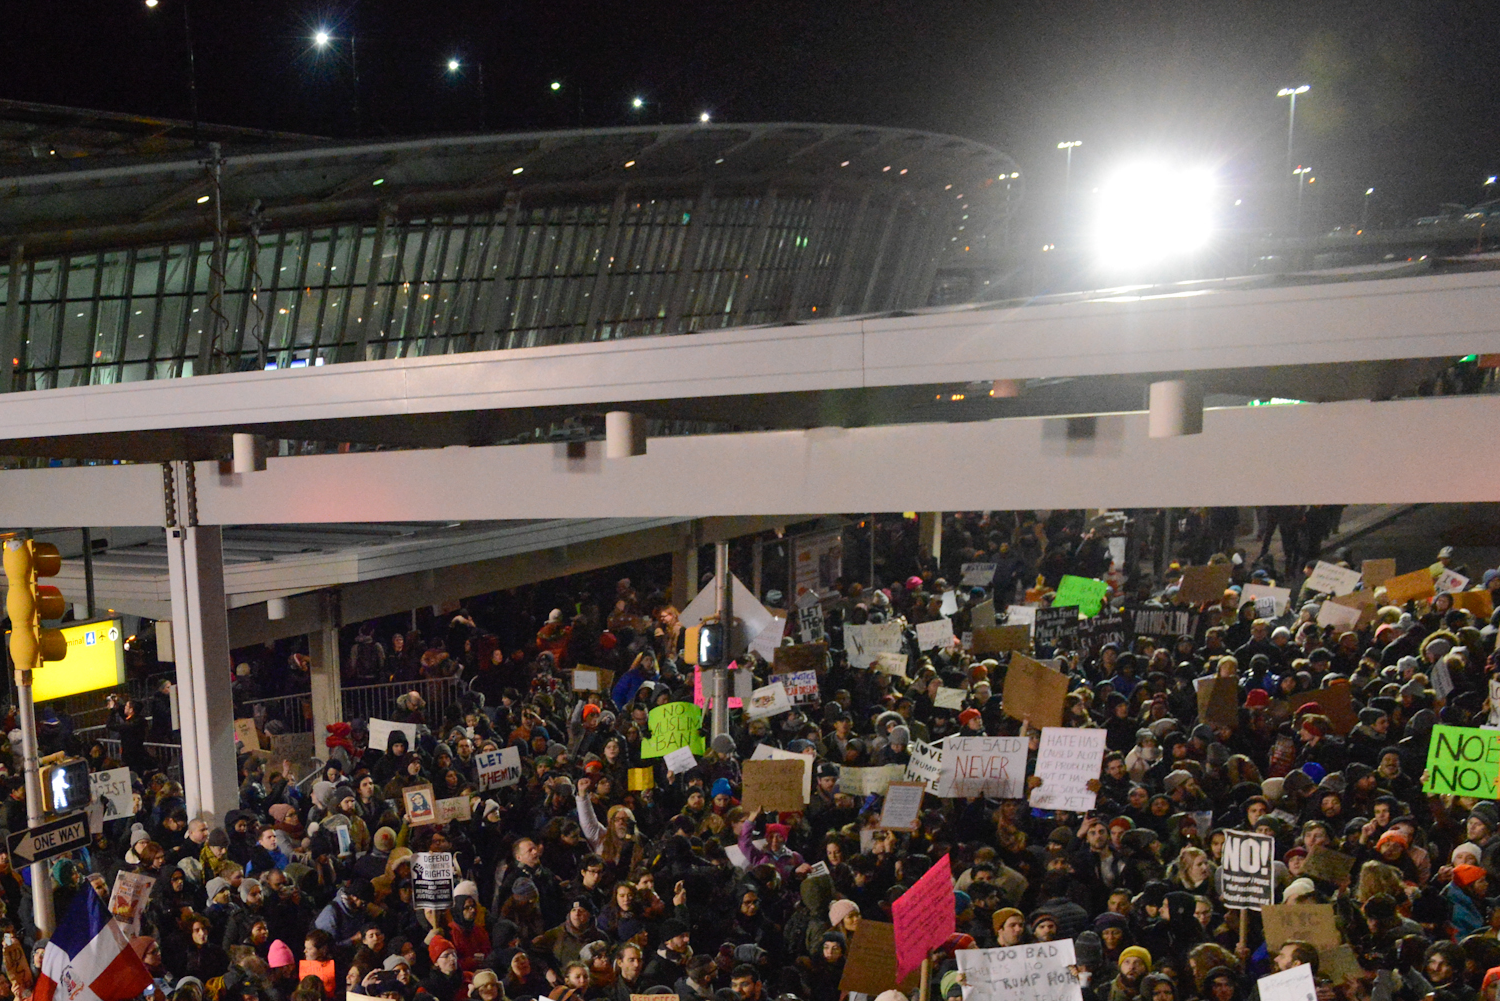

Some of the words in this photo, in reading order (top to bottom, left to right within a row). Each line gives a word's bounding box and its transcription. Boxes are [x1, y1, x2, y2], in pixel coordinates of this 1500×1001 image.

[801, 606, 819, 619] LET
[67, 636, 85, 646] minal
[87, 633, 95, 644] 4
[663, 704, 685, 718] NO
[652, 717, 700, 737] MUSLIM
[655, 732, 692, 752] BAN
[949, 737, 972, 751] WE
[983, 737, 1022, 754] SAID
[1047, 735, 1077, 747] HATE
[1078, 736, 1099, 748] HAS
[1435, 733, 1484, 762] NO
[478, 753, 502, 768] LET
[955, 754, 1009, 779] NEVER
[907, 770, 939, 791] HATE
[1064, 796, 1089, 807] YET
[34, 832, 57, 851] ONE
[60, 823, 82, 843] WAY
[424, 855, 450, 863] DEFEND
[1223, 836, 1269, 876] NO!
[425, 870, 450, 878] RIGHTS
[983, 950, 1017, 962] TOO
[1026, 945, 1058, 959] BAD
[986, 973, 1041, 991] TRUMP
